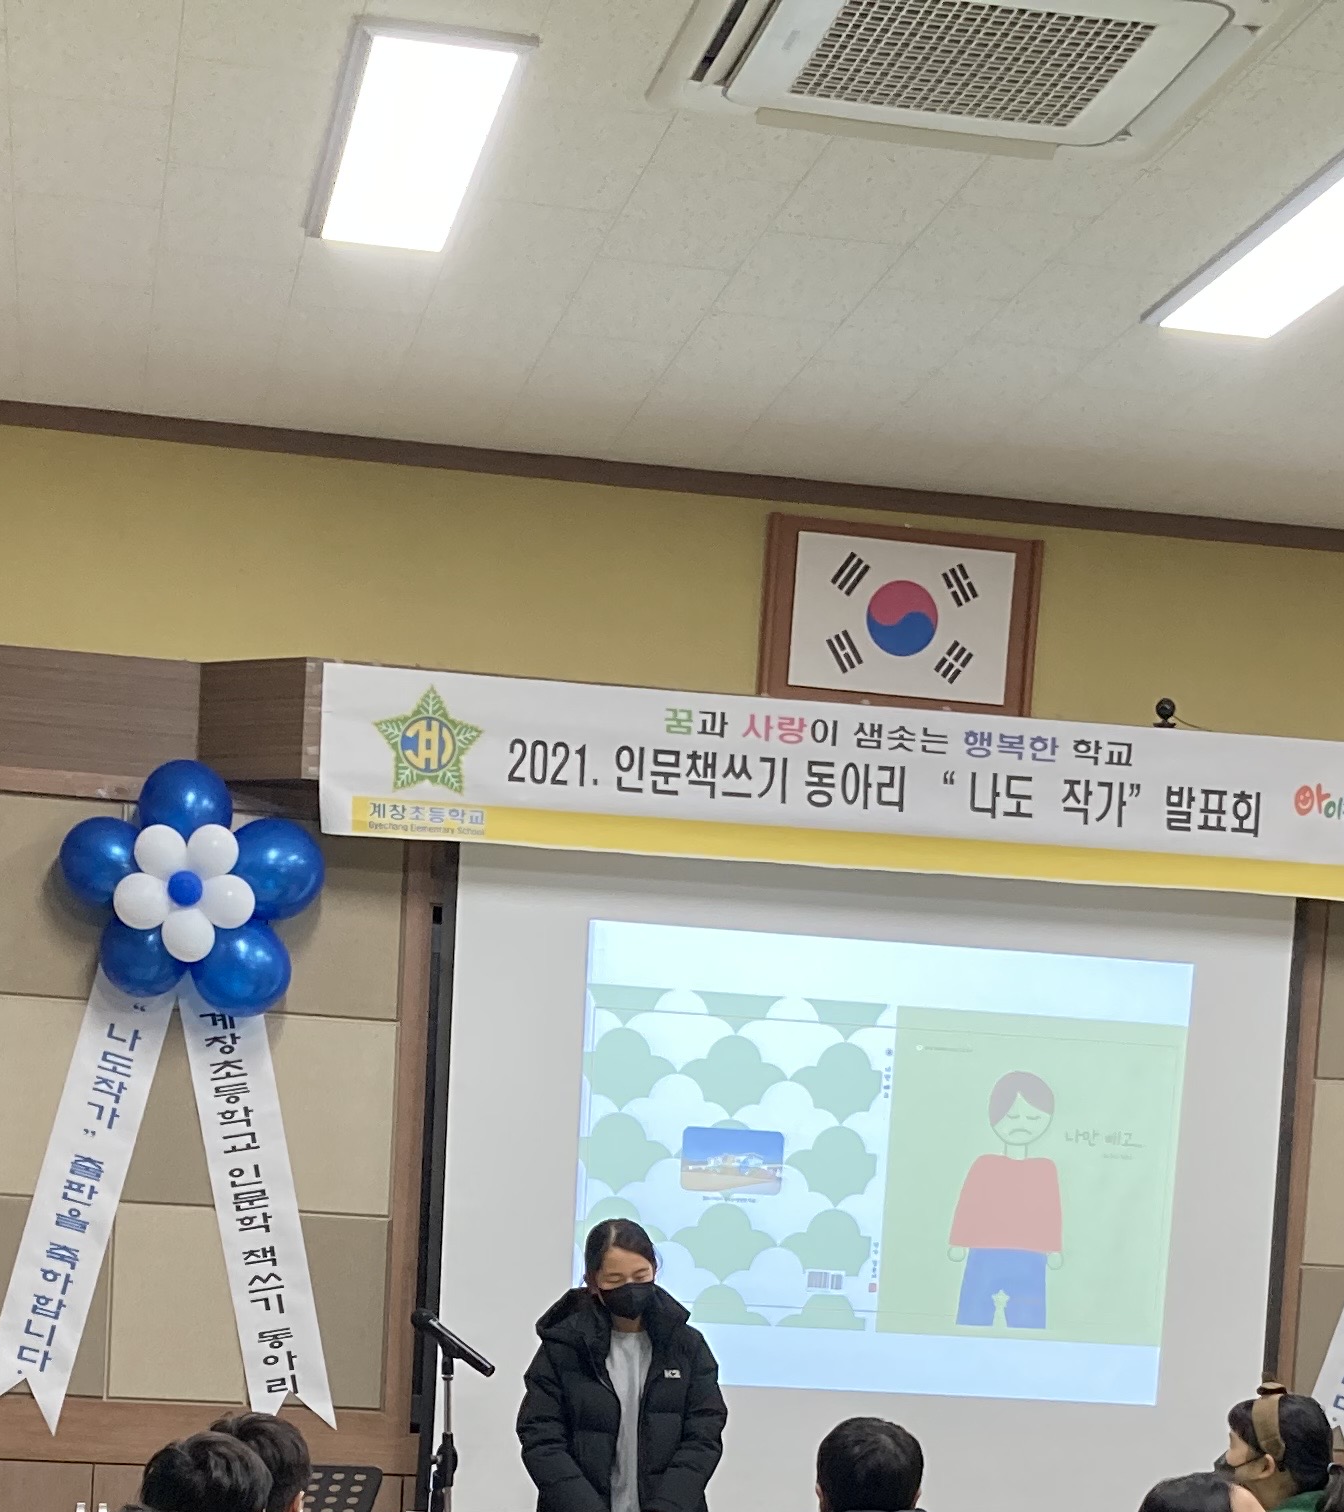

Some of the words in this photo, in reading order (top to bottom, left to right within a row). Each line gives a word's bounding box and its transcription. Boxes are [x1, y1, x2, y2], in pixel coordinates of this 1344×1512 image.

[664, 707, 729, 739] 꿈과
[742, 713, 839, 747] 사랑이
[853, 721, 949, 755] 샘솟는
[963, 729, 1059, 763] 행복한
[1072, 739, 1133, 767] 학교
[369, 802, 485, 825] 계창초등학교
[507, 738, 599, 787] 2021.
[614, 744, 789, 804] 인문책쓰기
[804, 756, 906, 813] 동아리
[1166, 785, 1261, 838] 발표회
[54, 1153, 105, 1234] 출판을
[16, 1242, 80, 1375] 축하합니다.
[228, 1163, 273, 1233] 인문학
[257, 1327, 299, 1395] 동아리
